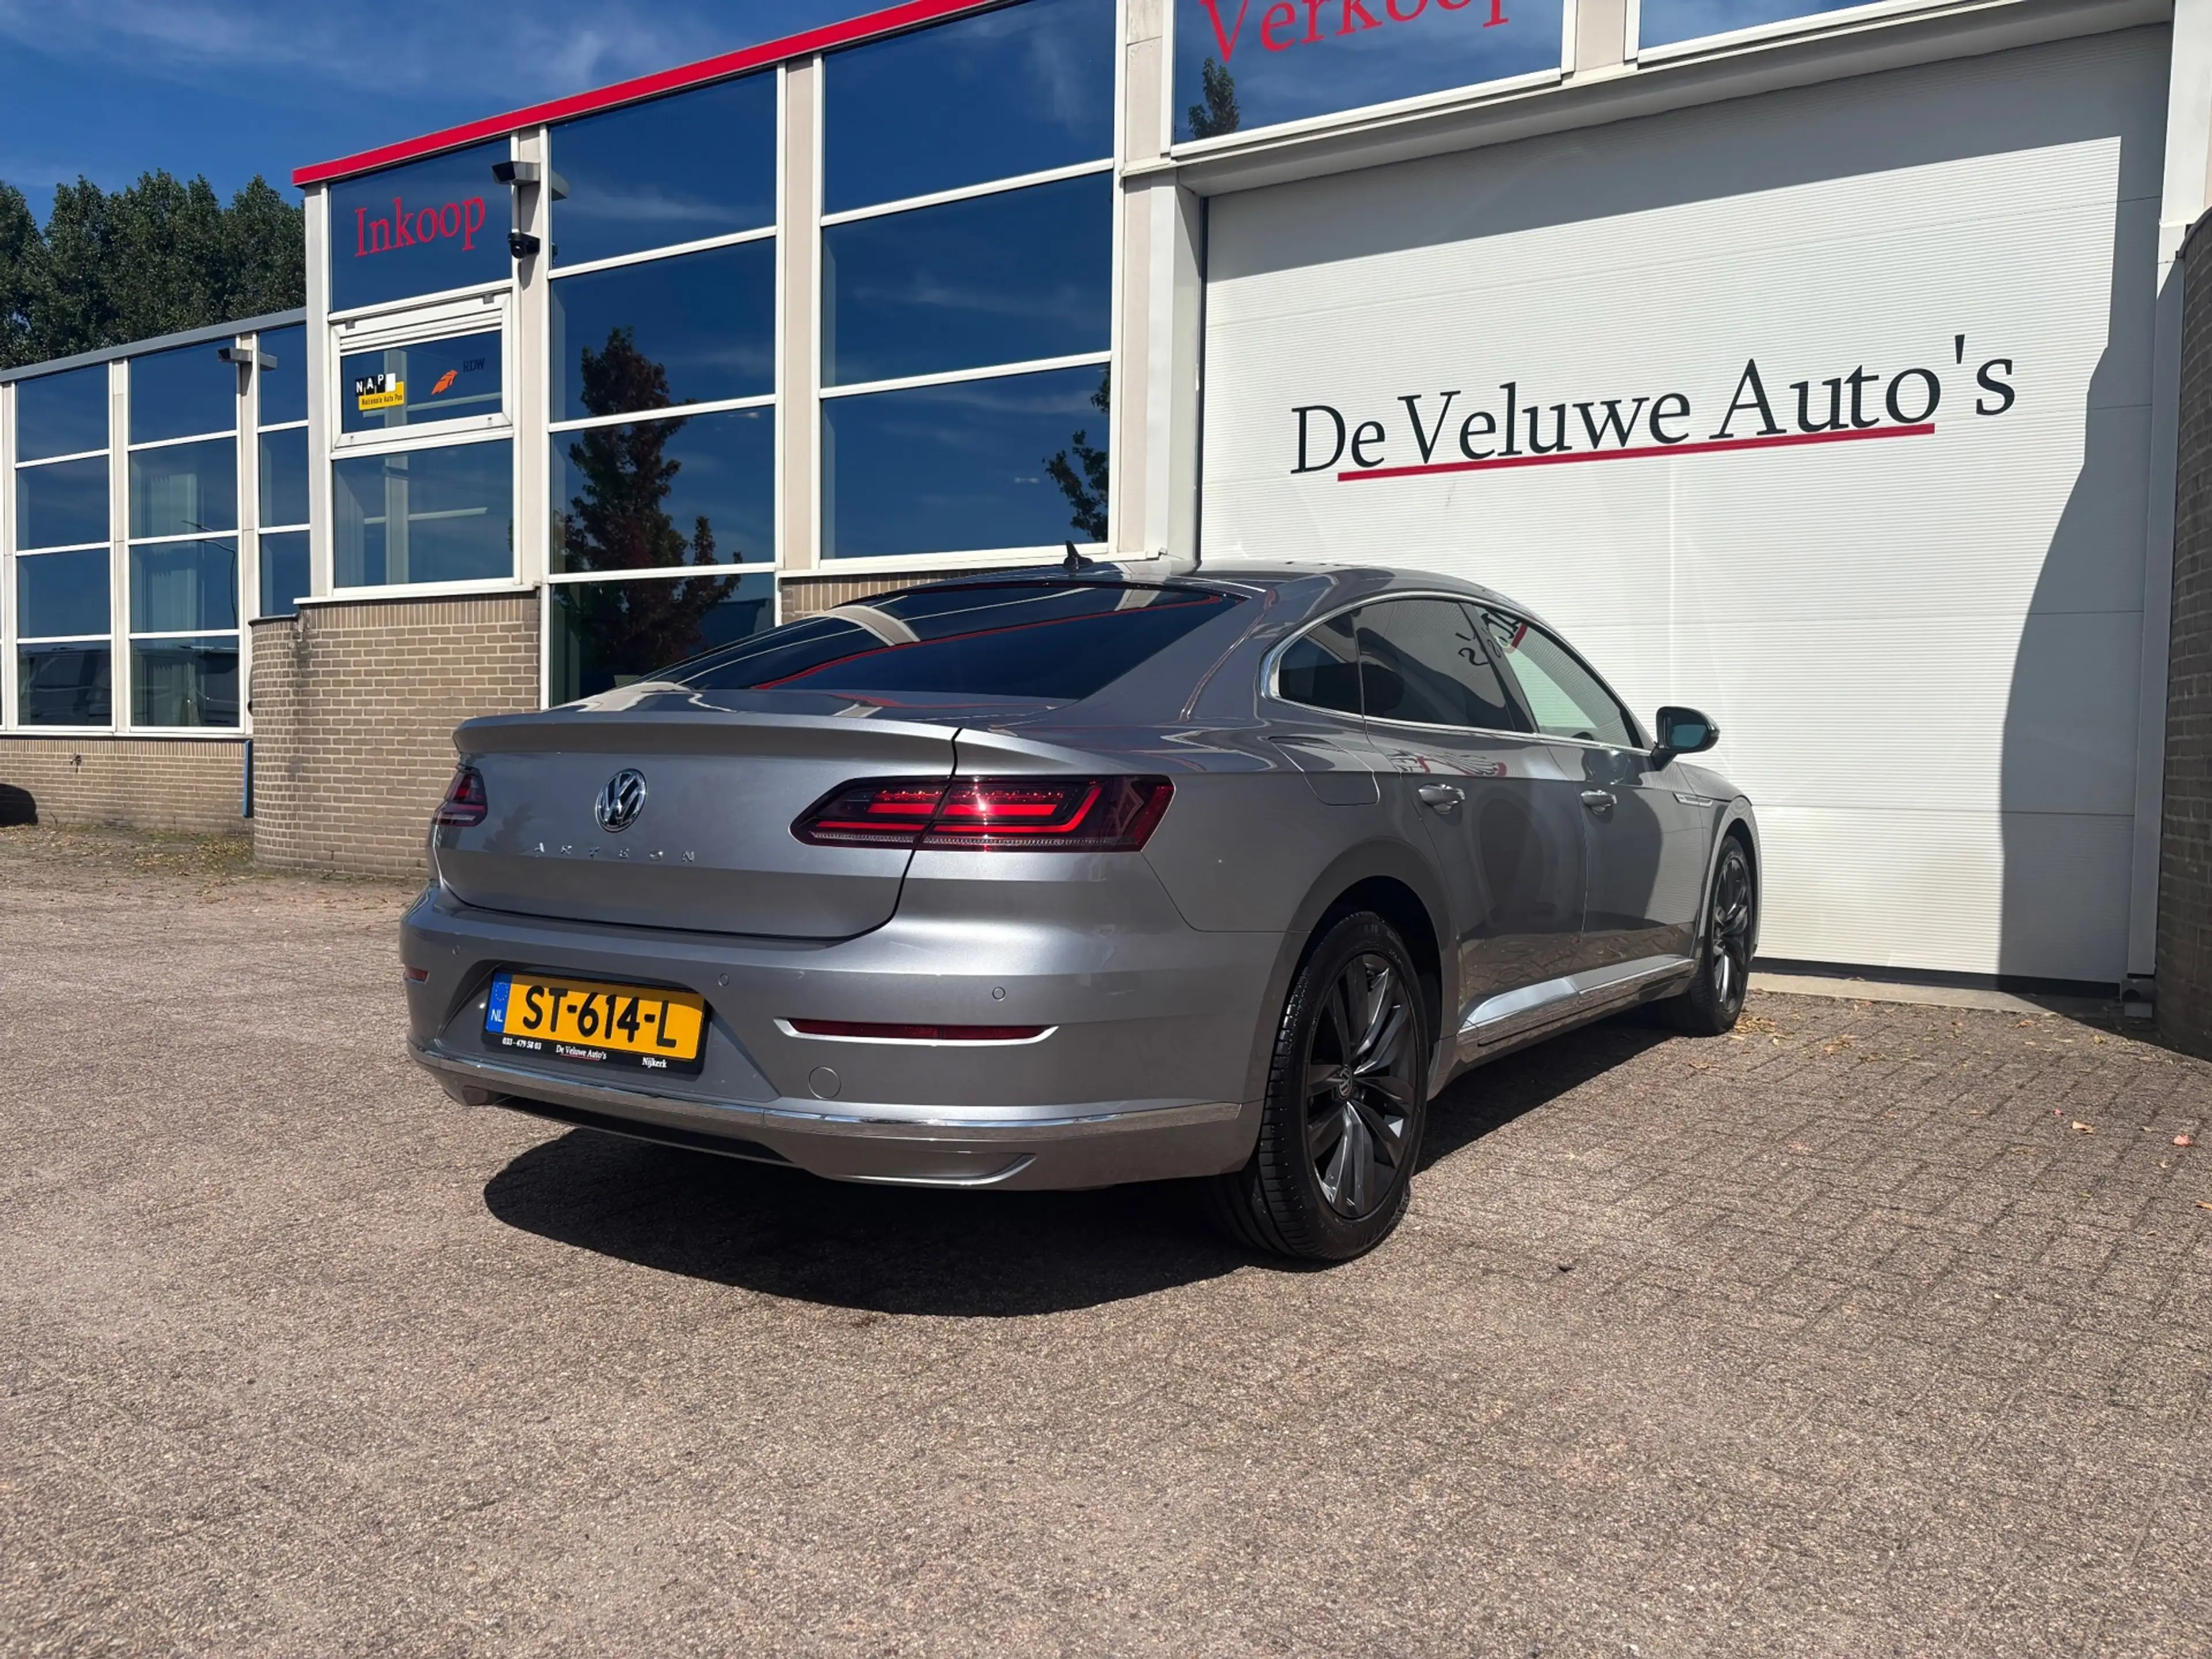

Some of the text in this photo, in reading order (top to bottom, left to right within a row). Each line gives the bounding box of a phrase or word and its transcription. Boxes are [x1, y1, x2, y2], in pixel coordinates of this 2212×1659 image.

[354, 196, 486, 257] Inkoop
[463, 358, 485, 372] RDW
[1290, 334, 2016, 474] De Veluwe Auto's
[490, 1008, 503, 1024] NL
[522, 985, 677, 1048] ST-614-L
[556, 1044, 565, 1054] De
[566, 1046, 586, 1057] Veluwe
[642, 1056, 667, 1069] Nijkerk
